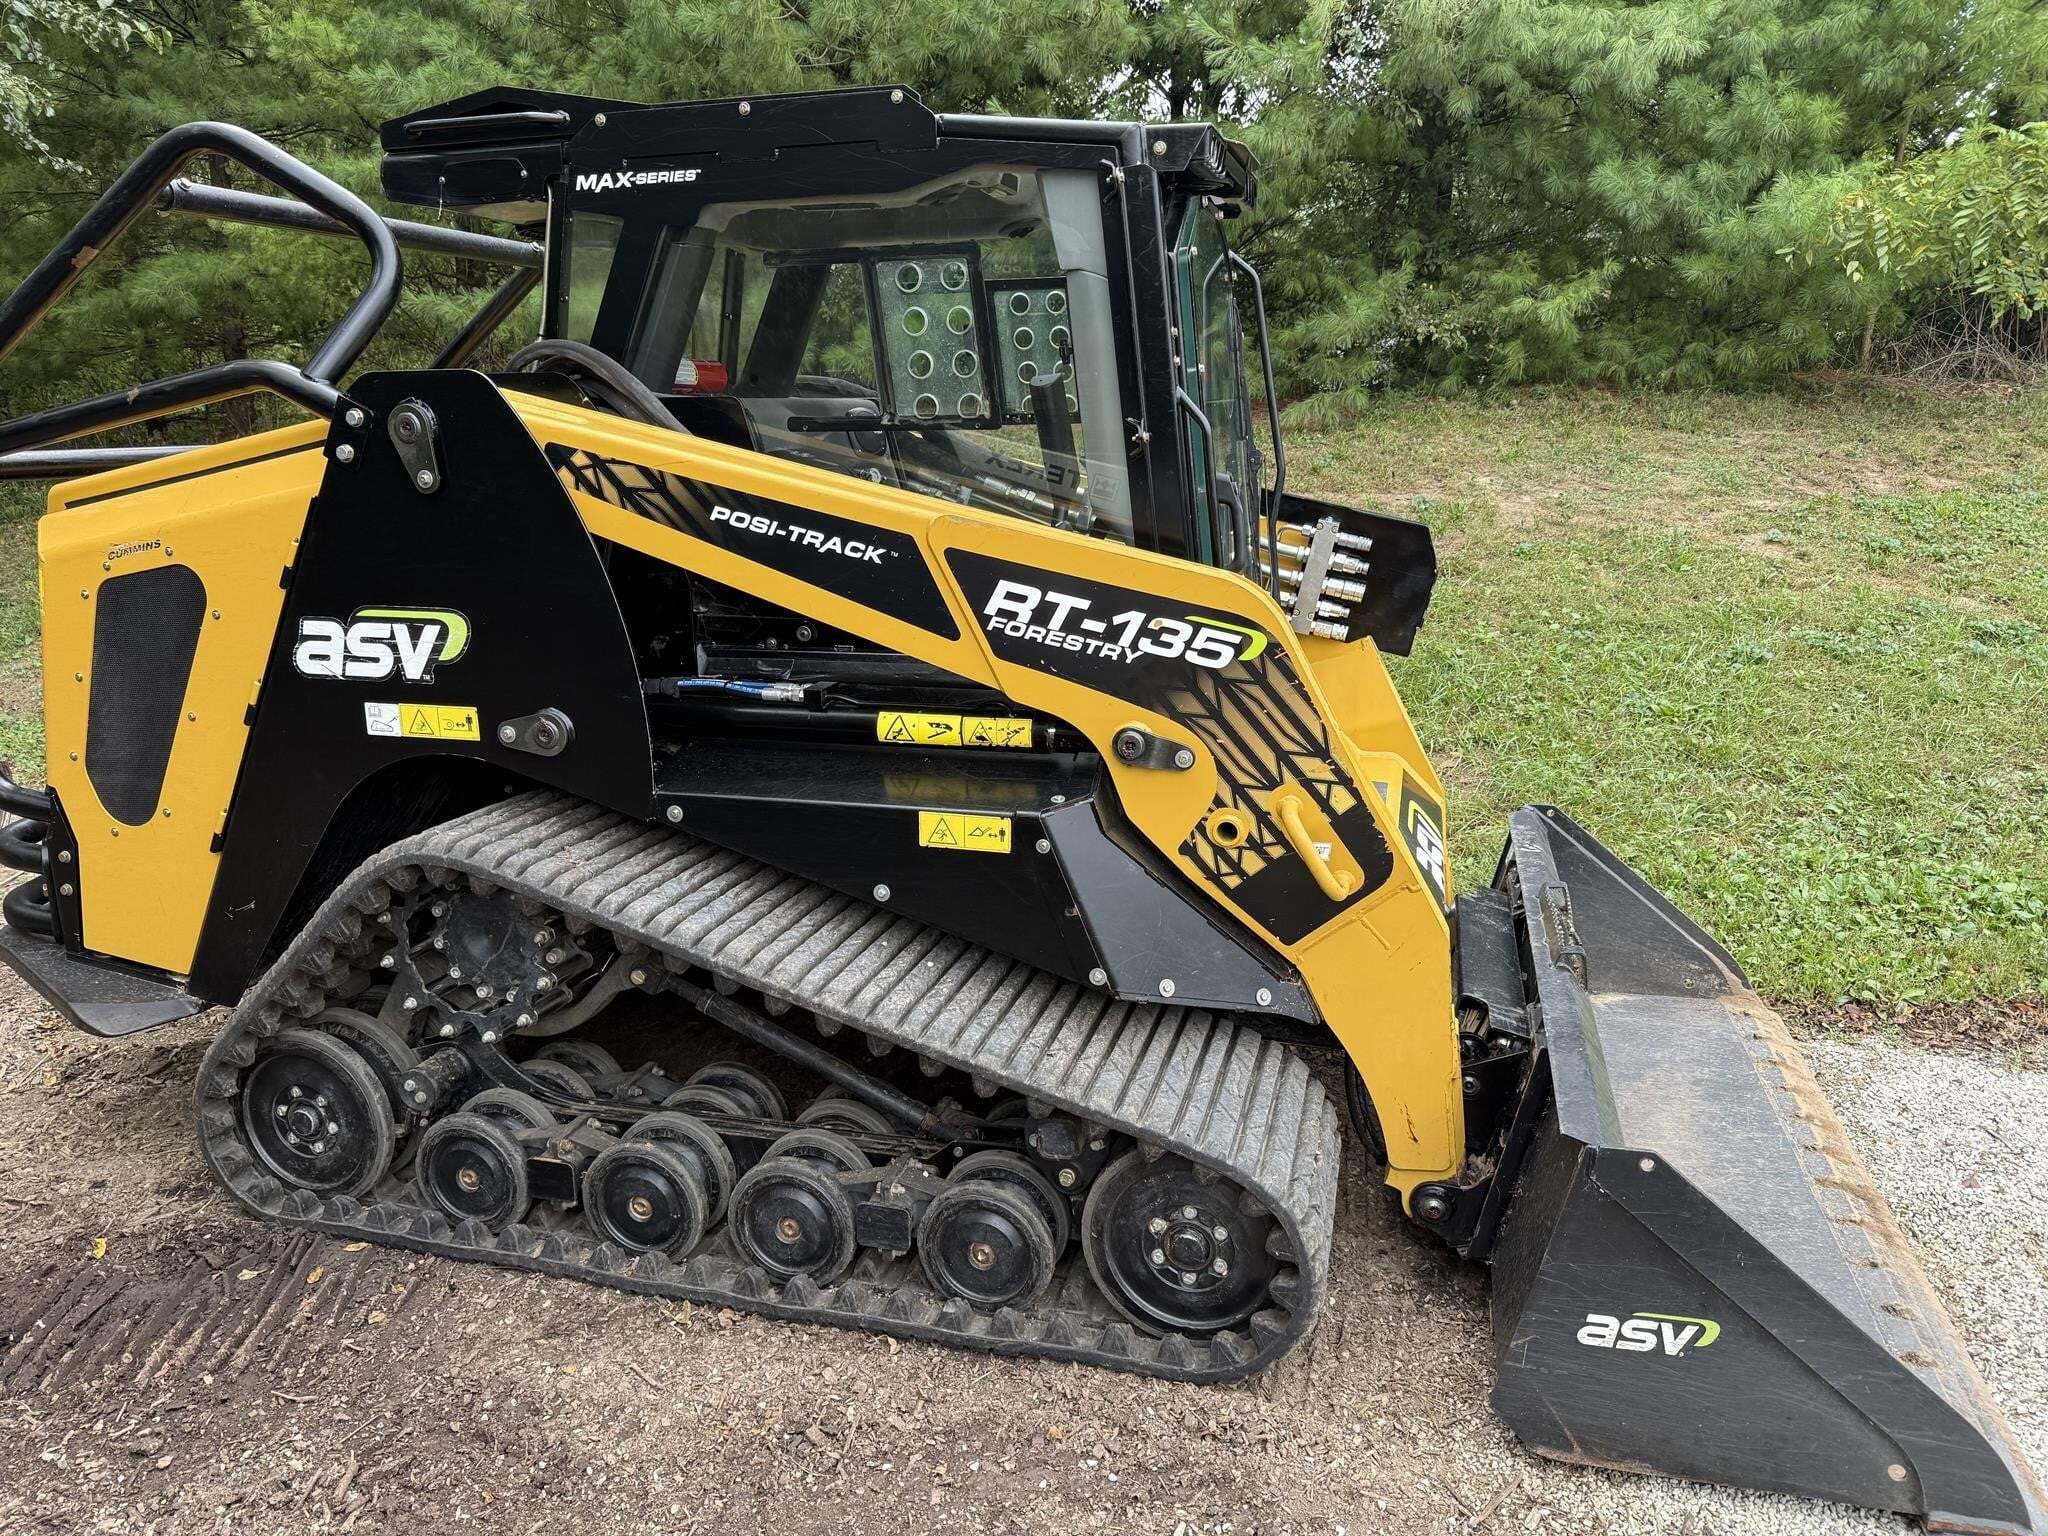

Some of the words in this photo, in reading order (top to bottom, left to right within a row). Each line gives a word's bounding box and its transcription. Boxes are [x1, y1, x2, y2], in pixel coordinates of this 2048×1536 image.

[575, 169, 698, 193] MAX-SERIES
[107, 539, 161, 561] CUMMINS
[709, 505, 887, 564] POSI-TRACK
[983, 579, 1243, 669] RT-135
[986, 616, 1146, 664] FORESTRY
[296, 620, 441, 680] asv
[1576, 1313, 1700, 1356] asv
